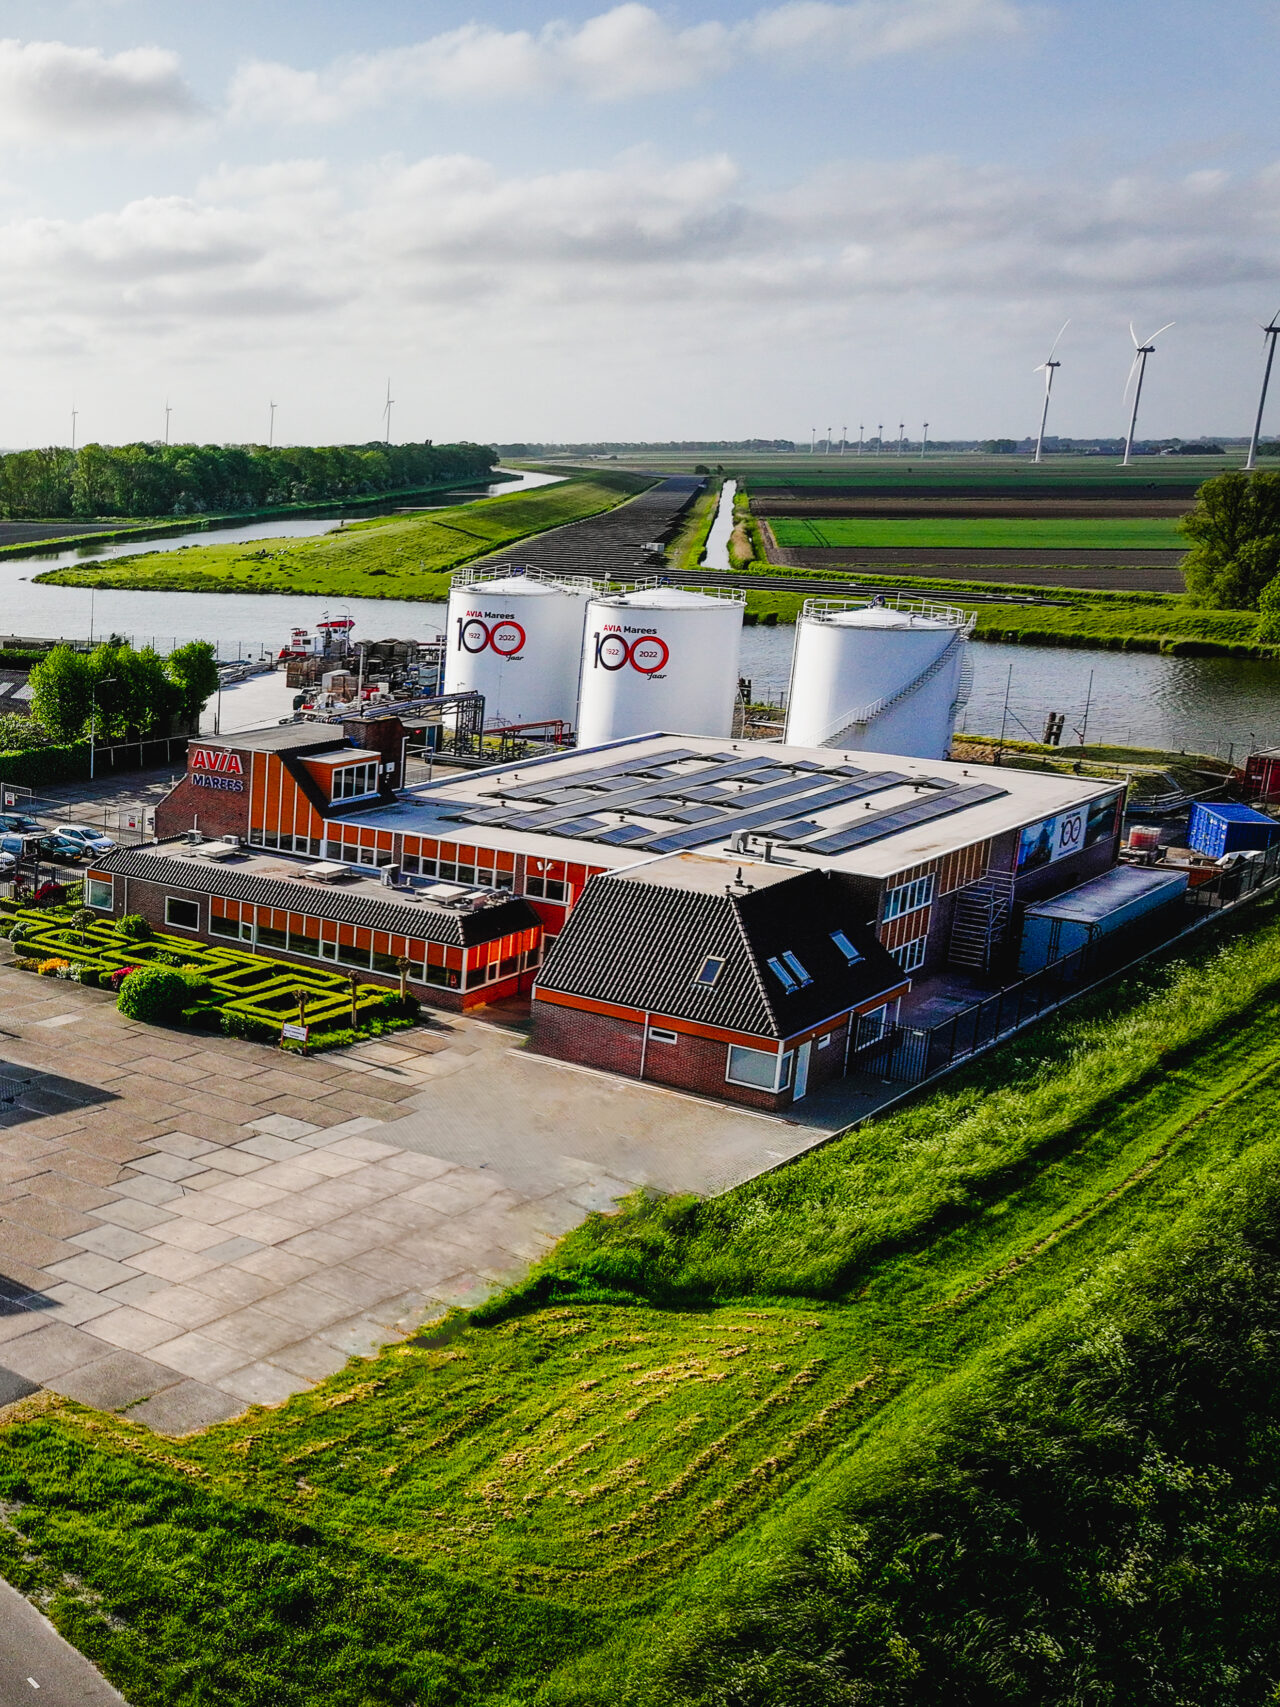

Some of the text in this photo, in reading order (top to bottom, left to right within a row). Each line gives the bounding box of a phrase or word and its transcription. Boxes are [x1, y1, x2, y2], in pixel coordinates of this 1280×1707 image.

[466, 610, 515, 620] AVIA Marees
[603, 624, 658, 634] AVIA Marees
[456, 617, 526, 656] 100
[593, 632, 669, 674] 100
[639, 650, 658, 658] 2022
[192, 773, 243, 792] MAREES
